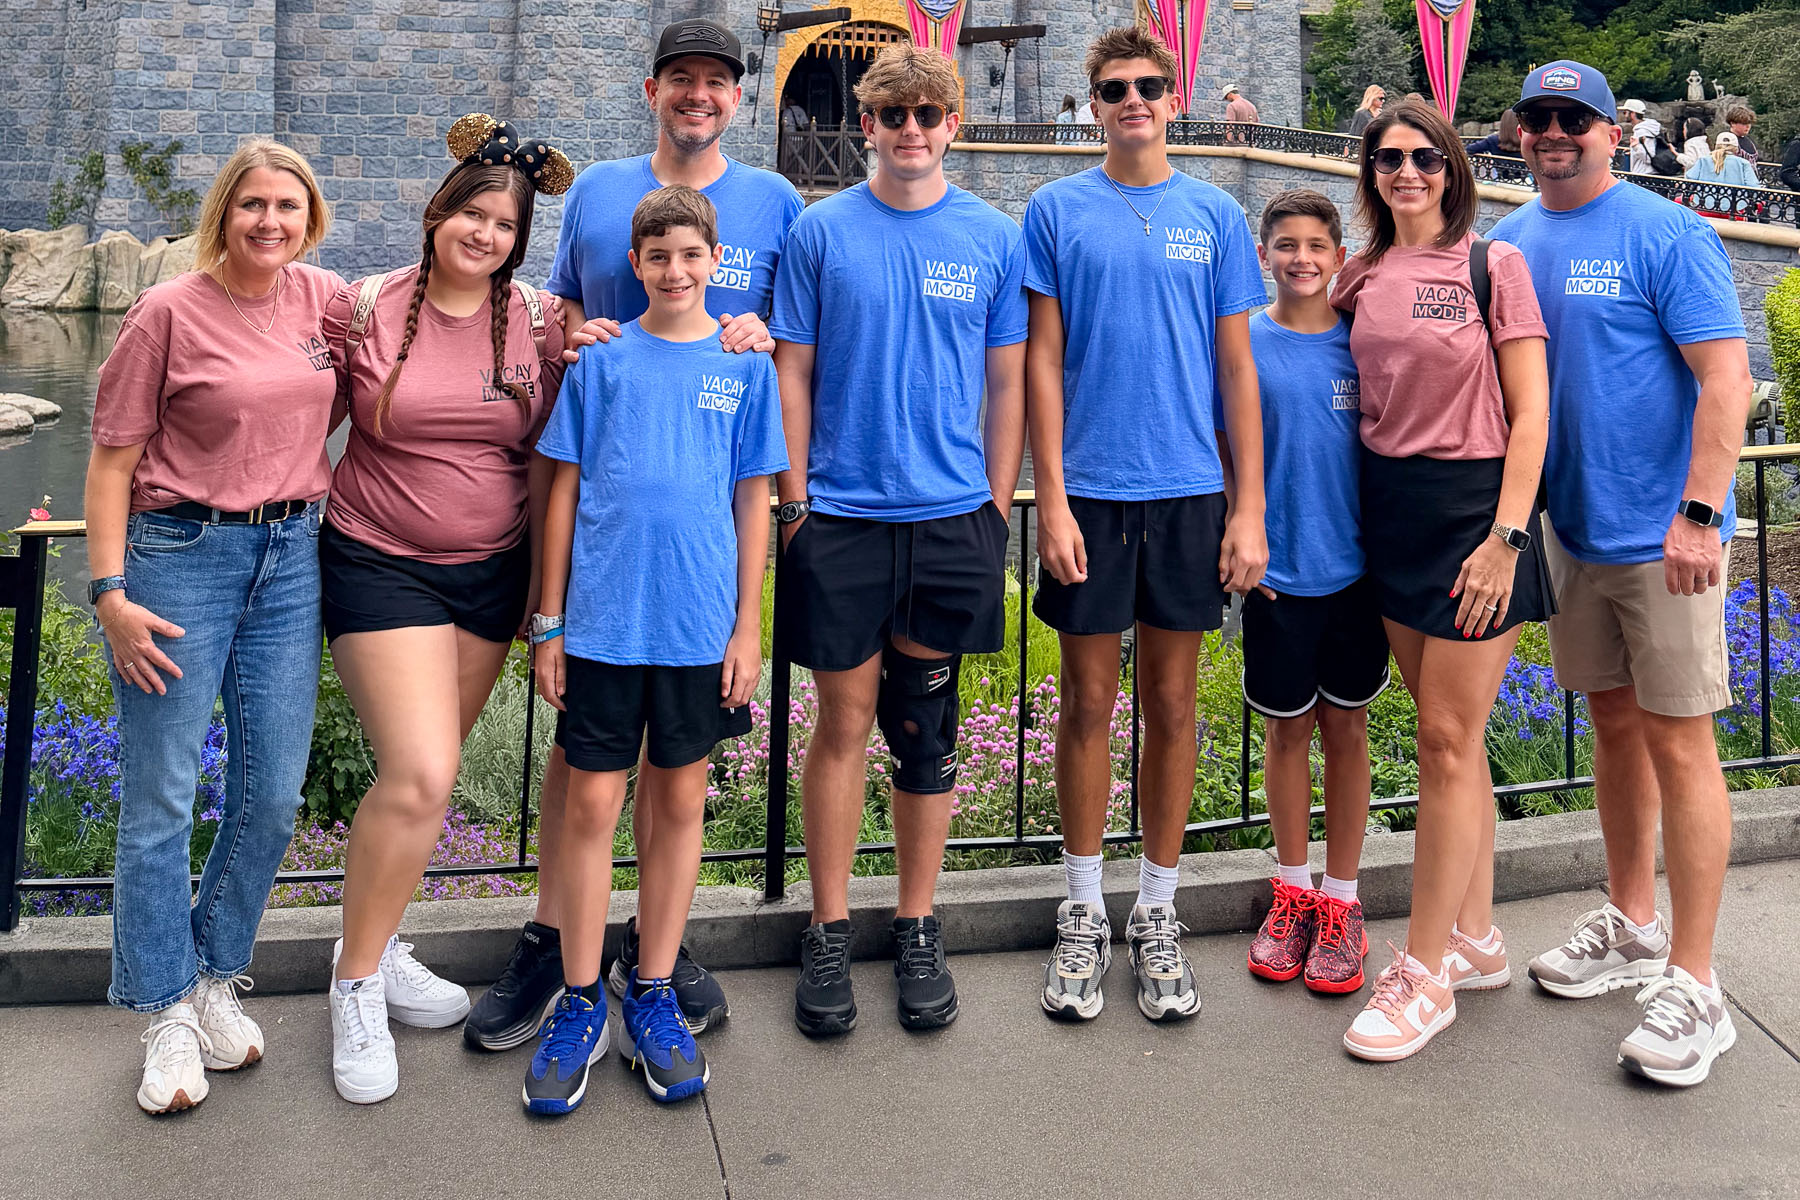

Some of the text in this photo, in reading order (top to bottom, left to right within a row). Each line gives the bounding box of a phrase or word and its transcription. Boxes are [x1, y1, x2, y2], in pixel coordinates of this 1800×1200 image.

[1546, 76, 1576, 85] PING
[1165, 226, 1213, 247] VACAY
[720, 244, 756, 268] CAY
[1167, 245, 1210, 262] MODE
[926, 259, 979, 283] VACAY
[1570, 259, 1625, 277] VACAY
[709, 267, 750, 289] ODE
[1566, 279, 1619, 295] MODE
[924, 280, 975, 301] MODE
[1415, 286, 1469, 305] VACAY
[1413, 304, 1466, 321] MODE
[297, 336, 327, 355] VA
[310, 352, 333, 369] MO
[479, 363, 531, 384] VCAY
[484, 382, 535, 401] MOE
[702, 374, 749, 399] VACAY
[1331, 379, 1358, 394] VAC
[699, 393, 739, 413] MODE
[1334, 396, 1360, 408] MOD
[1071, 903, 1087, 911] NIKE
